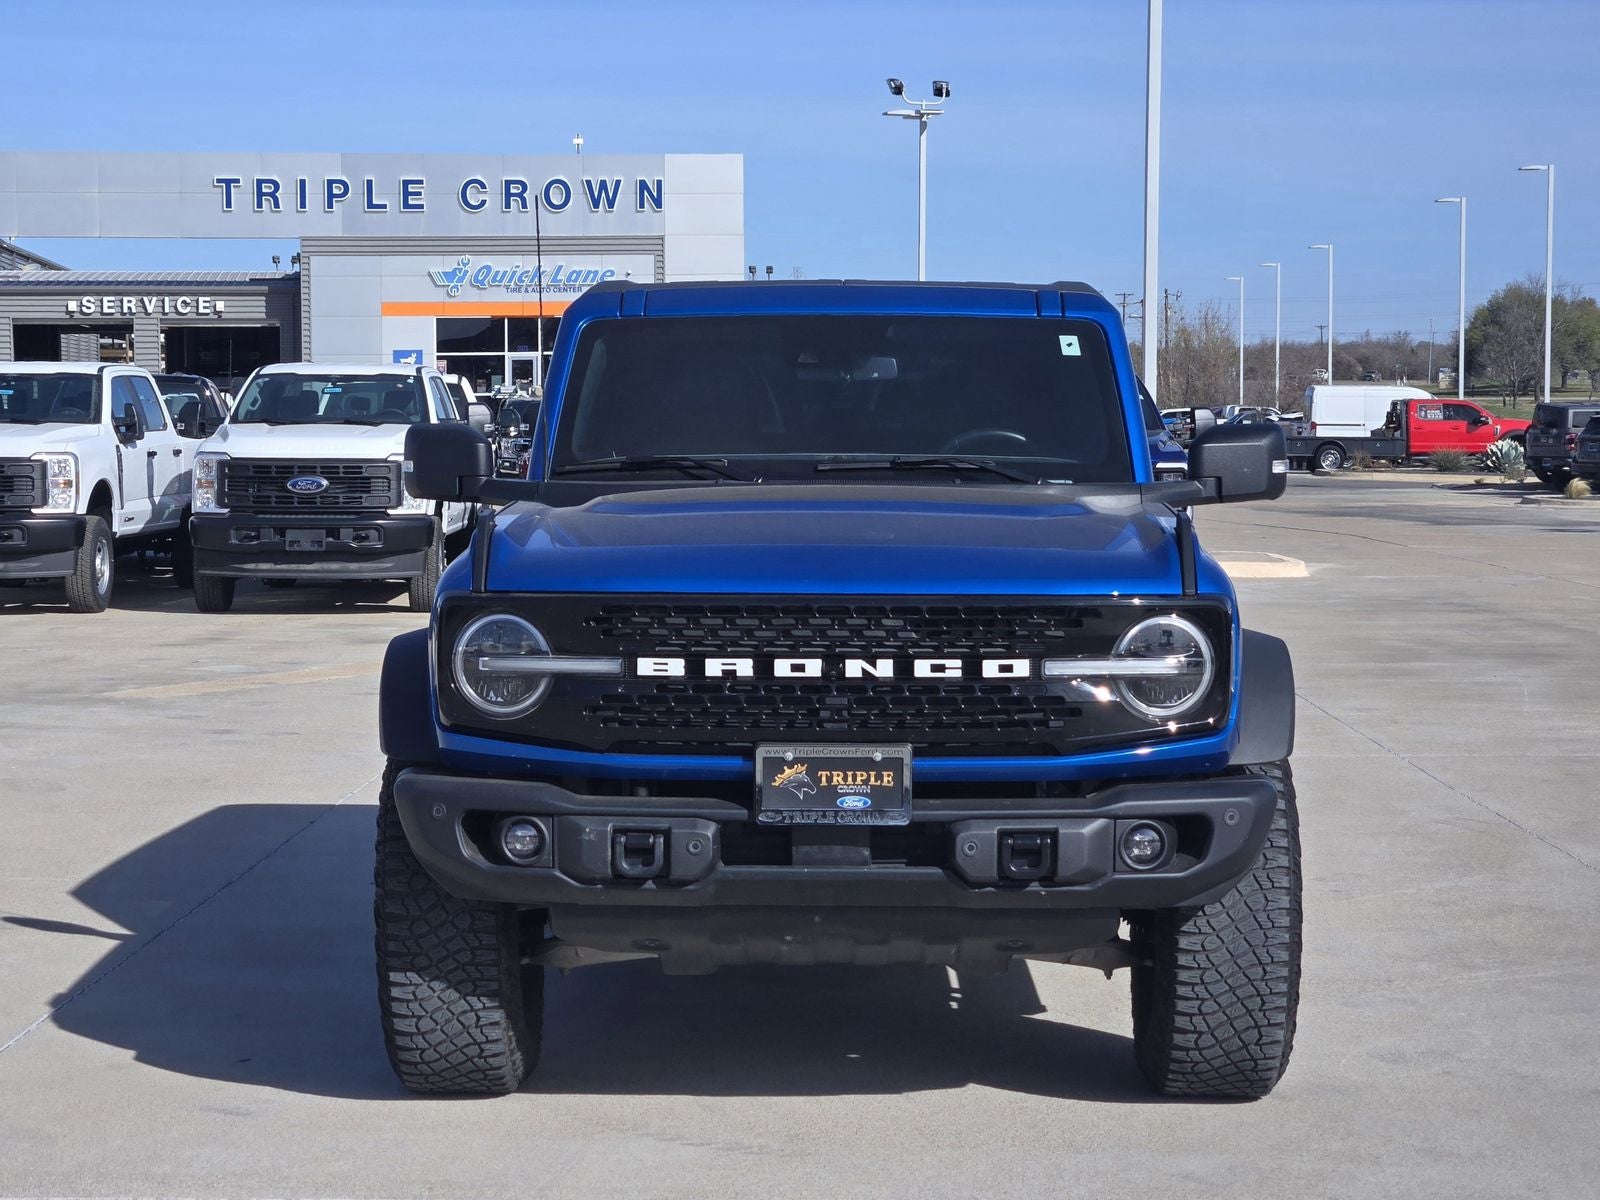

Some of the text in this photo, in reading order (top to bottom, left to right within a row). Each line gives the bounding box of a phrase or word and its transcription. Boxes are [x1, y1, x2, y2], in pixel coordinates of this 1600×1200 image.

[213, 176, 666, 213] TRIPLE CROWN
[472, 264, 615, 288] Quick Lane
[505, 286, 583, 294] TIRE & AUTO CENTER
[81, 296, 211, 314] SERVICE
[636, 657, 1030, 677] BRONCO
[818, 771, 894, 787] TRIPLE
[837, 785, 871, 793] CROWN
[783, 811, 836, 823] TRIPLE
